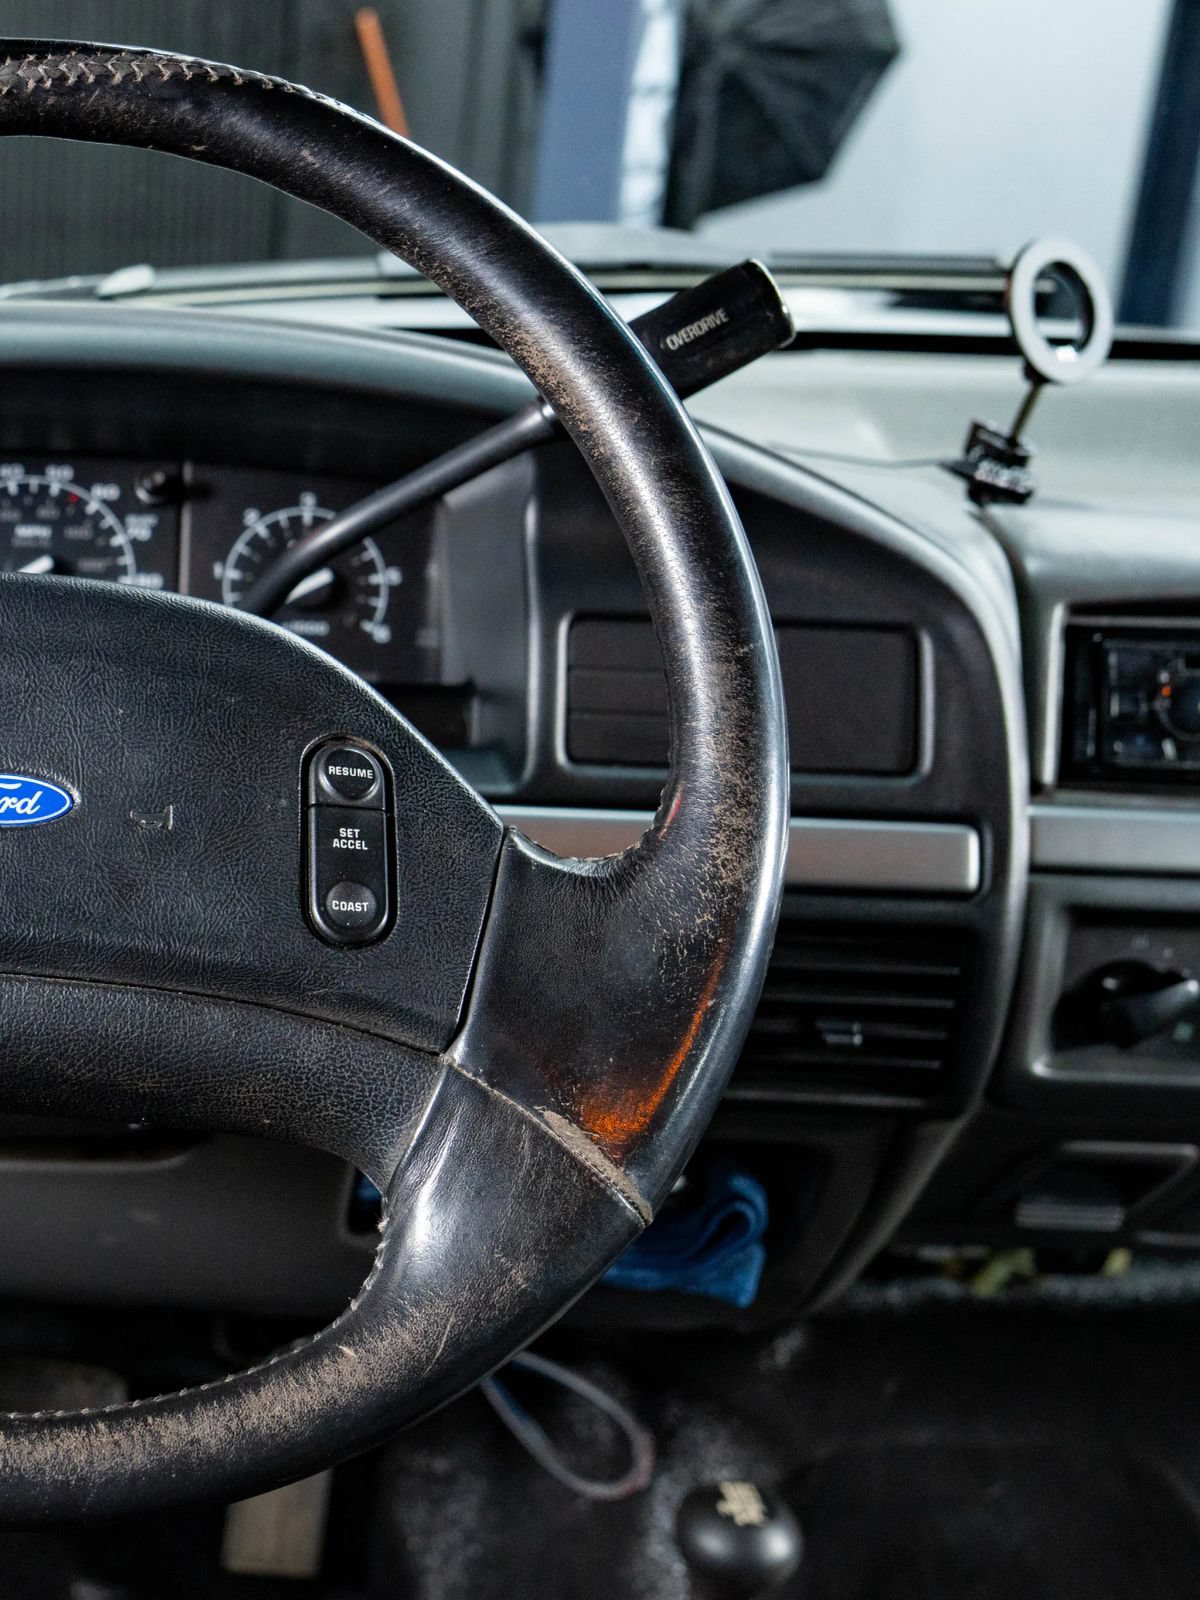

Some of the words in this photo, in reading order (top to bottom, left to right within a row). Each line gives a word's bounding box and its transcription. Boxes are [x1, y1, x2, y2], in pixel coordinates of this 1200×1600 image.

[665, 307, 729, 351] OVERDRIVE
[328, 766, 373, 779] RESUME
[339, 828, 360, 839] SET
[332, 838, 368, 850] ACCEL
[331, 900, 369, 912] COAST
